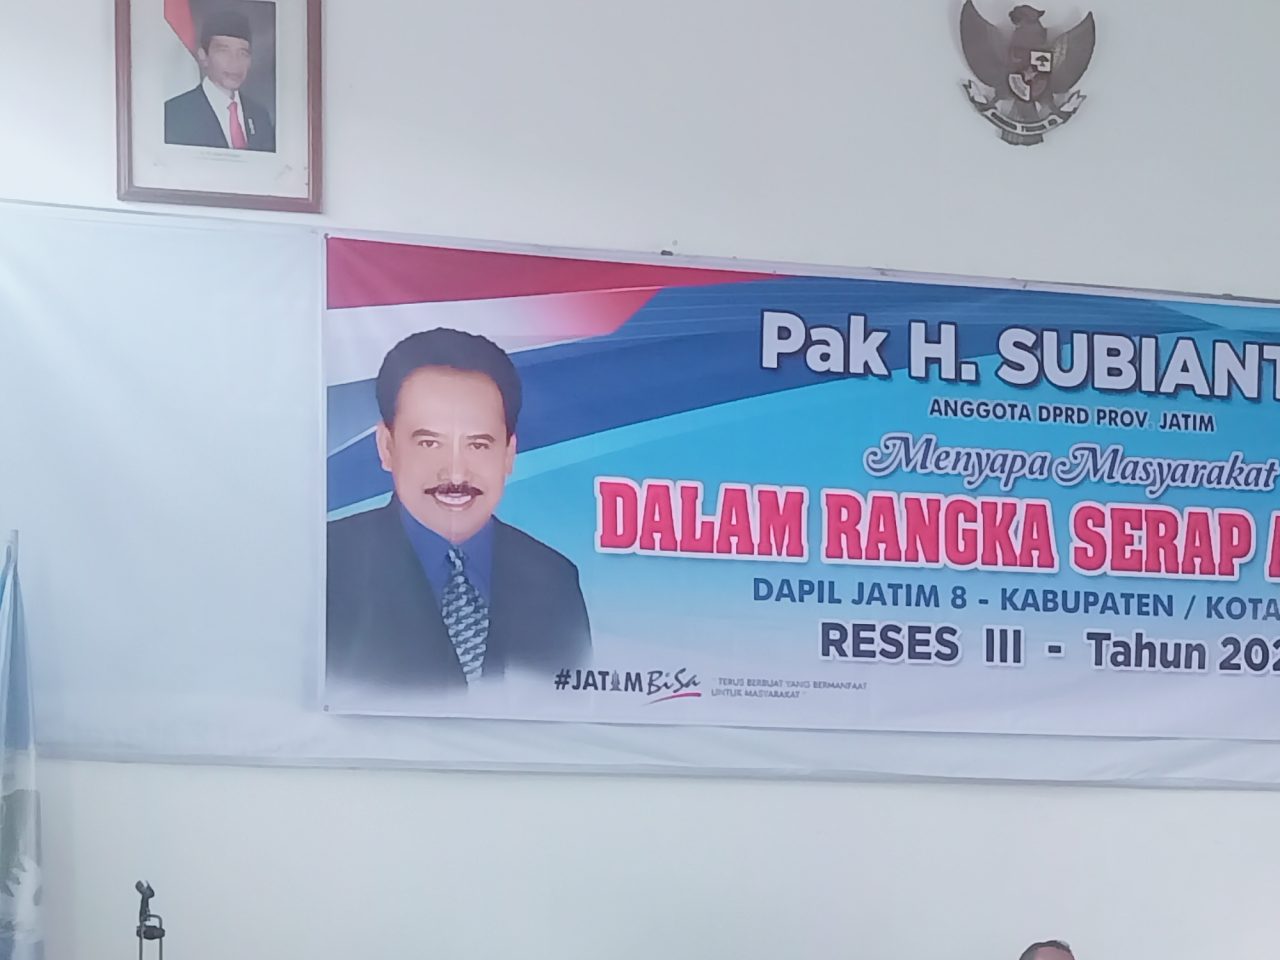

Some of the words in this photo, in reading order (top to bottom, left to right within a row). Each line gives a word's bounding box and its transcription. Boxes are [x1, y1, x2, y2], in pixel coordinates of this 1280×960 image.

[760, 309, 891, 377] Pak
[908, 320, 978, 382] H.
[929, 398, 1032, 421] ANGGOTA
[1039, 405, 1090, 424] DPRD
[1159, 412, 1215, 432] JATIM
[865, 435, 1048, 488] Menyapa
[1055, 445, 1279, 497] Masyarakat
[599, 481, 805, 557] DALAM
[825, 493, 1056, 568] RANGKA
[1073, 505, 1252, 576] SERAP
[753, 577, 842, 604] DAPIL
[851, 582, 940, 608] JATIM
[950, 586, 967, 609] 8
[1001, 587, 1174, 617] KABUPATEN
[1184, 594, 1196, 620] /
[1206, 596, 1280, 621] KOTA
[820, 621, 959, 662] RESES
[985, 628, 1021, 663] III
[1086, 632, 1206, 670] Tahun
